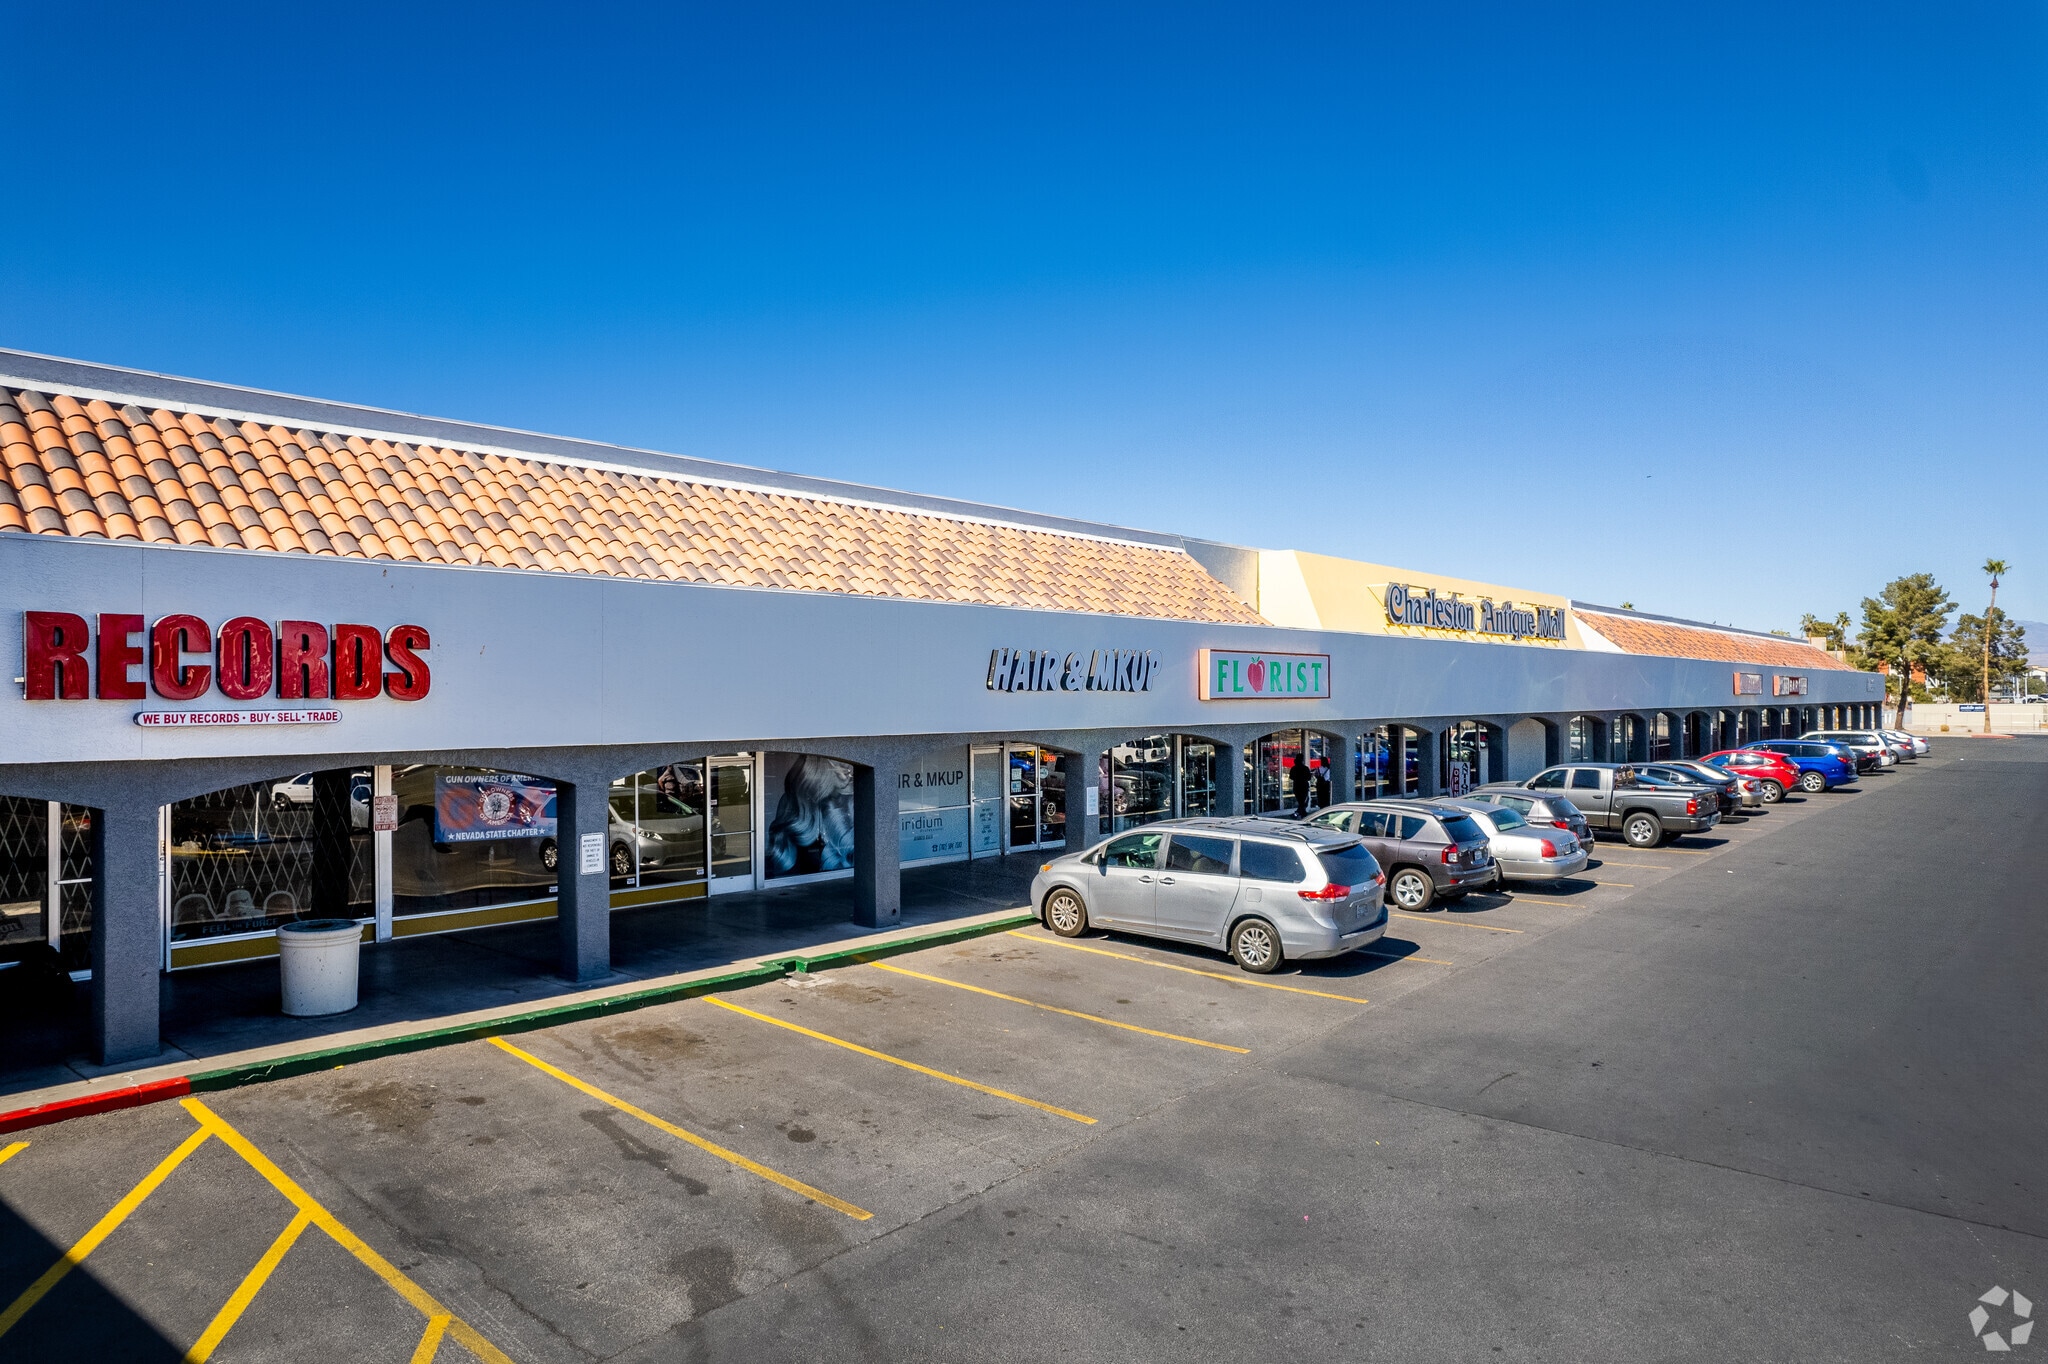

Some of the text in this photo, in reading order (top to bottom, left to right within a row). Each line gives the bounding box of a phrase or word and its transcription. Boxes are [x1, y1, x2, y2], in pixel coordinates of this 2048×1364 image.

[1384, 582, 1567, 640] Charleston Antique Mall
[22, 610, 431, 701] RECORDS
[987, 647, 1163, 693] HAIR & MKUP
[142, 711, 338, 725] WE BUY RECORDS BUY SELL TRADE
[445, 775, 464, 783] GUN
[464, 775, 499, 783] OWNERS
[511, 774, 541, 782] AMERI
[898, 770, 963, 788] IR & MKUP
[901, 816, 943, 831] iridium
[455, 828, 538, 840] NEVADA STATE CHAPTER
[202, 923, 231, 935] FEEL
[245, 918, 279, 929] FORCE
